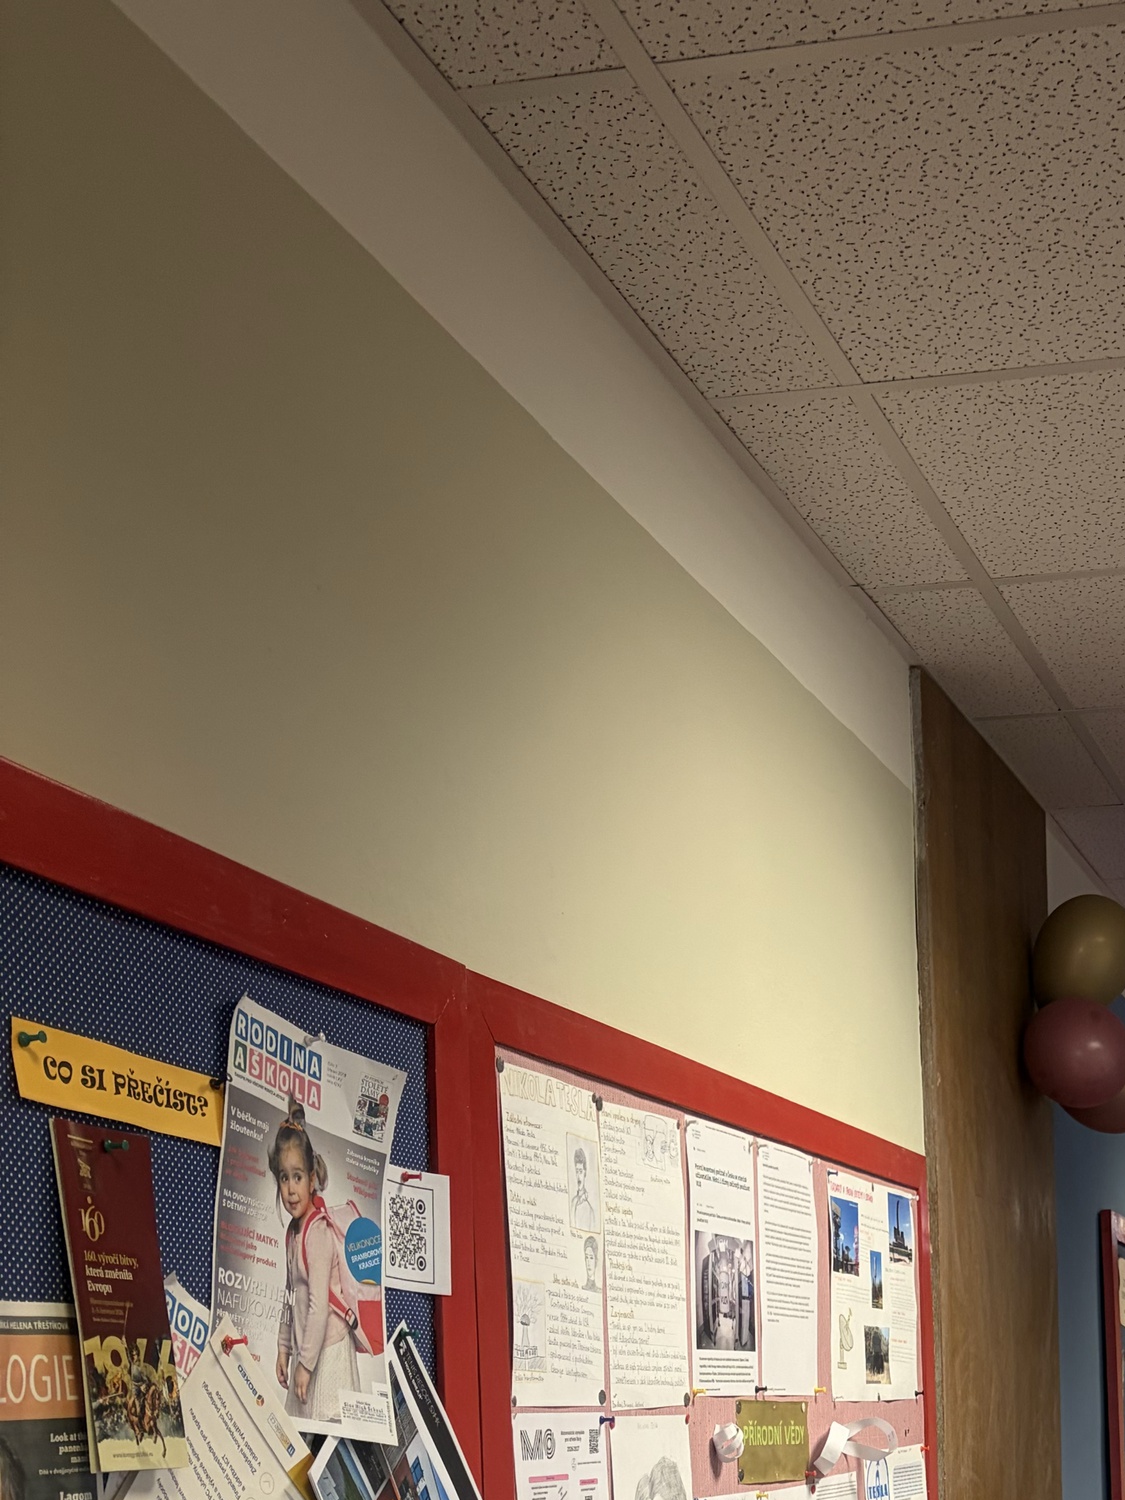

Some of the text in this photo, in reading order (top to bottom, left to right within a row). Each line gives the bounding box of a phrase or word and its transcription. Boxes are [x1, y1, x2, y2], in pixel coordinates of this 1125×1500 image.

[236, 1011, 321, 1080] RODINA
[43, 1056, 73, 1084] CO
[81, 1064, 107, 1091] SI
[112, 1068, 209, 1117] PŘEČÍST?
[503, 1067, 596, 1122] NIKOLA TESLA
[78, 1205, 105, 1242] 160
[256, 1233, 279, 1249] MATKY:
[85, 1264, 133, 1280] která změnila
[218, 1267, 267, 1297] ROZVRH
[87, 1281, 112, 1295] Evropu
[217, 1287, 290, 1325] NAFUKOVACÍ!
[10, 1321, 33, 1330] HELENA
[0, 1354, 79, 1404] OGIE
[236, 1364, 259, 1396] BOXED
[225, 1410, 234, 1422] ICT
[50, 1432, 69, 1442] Look
[743, 1420, 804, 1446] PŘÍRODNÍ VĚDY
[204, 1441, 227, 1474] prostředky
[221, 1454, 230, 1466] ICT
[204, 1489, 213, 1500] PC
